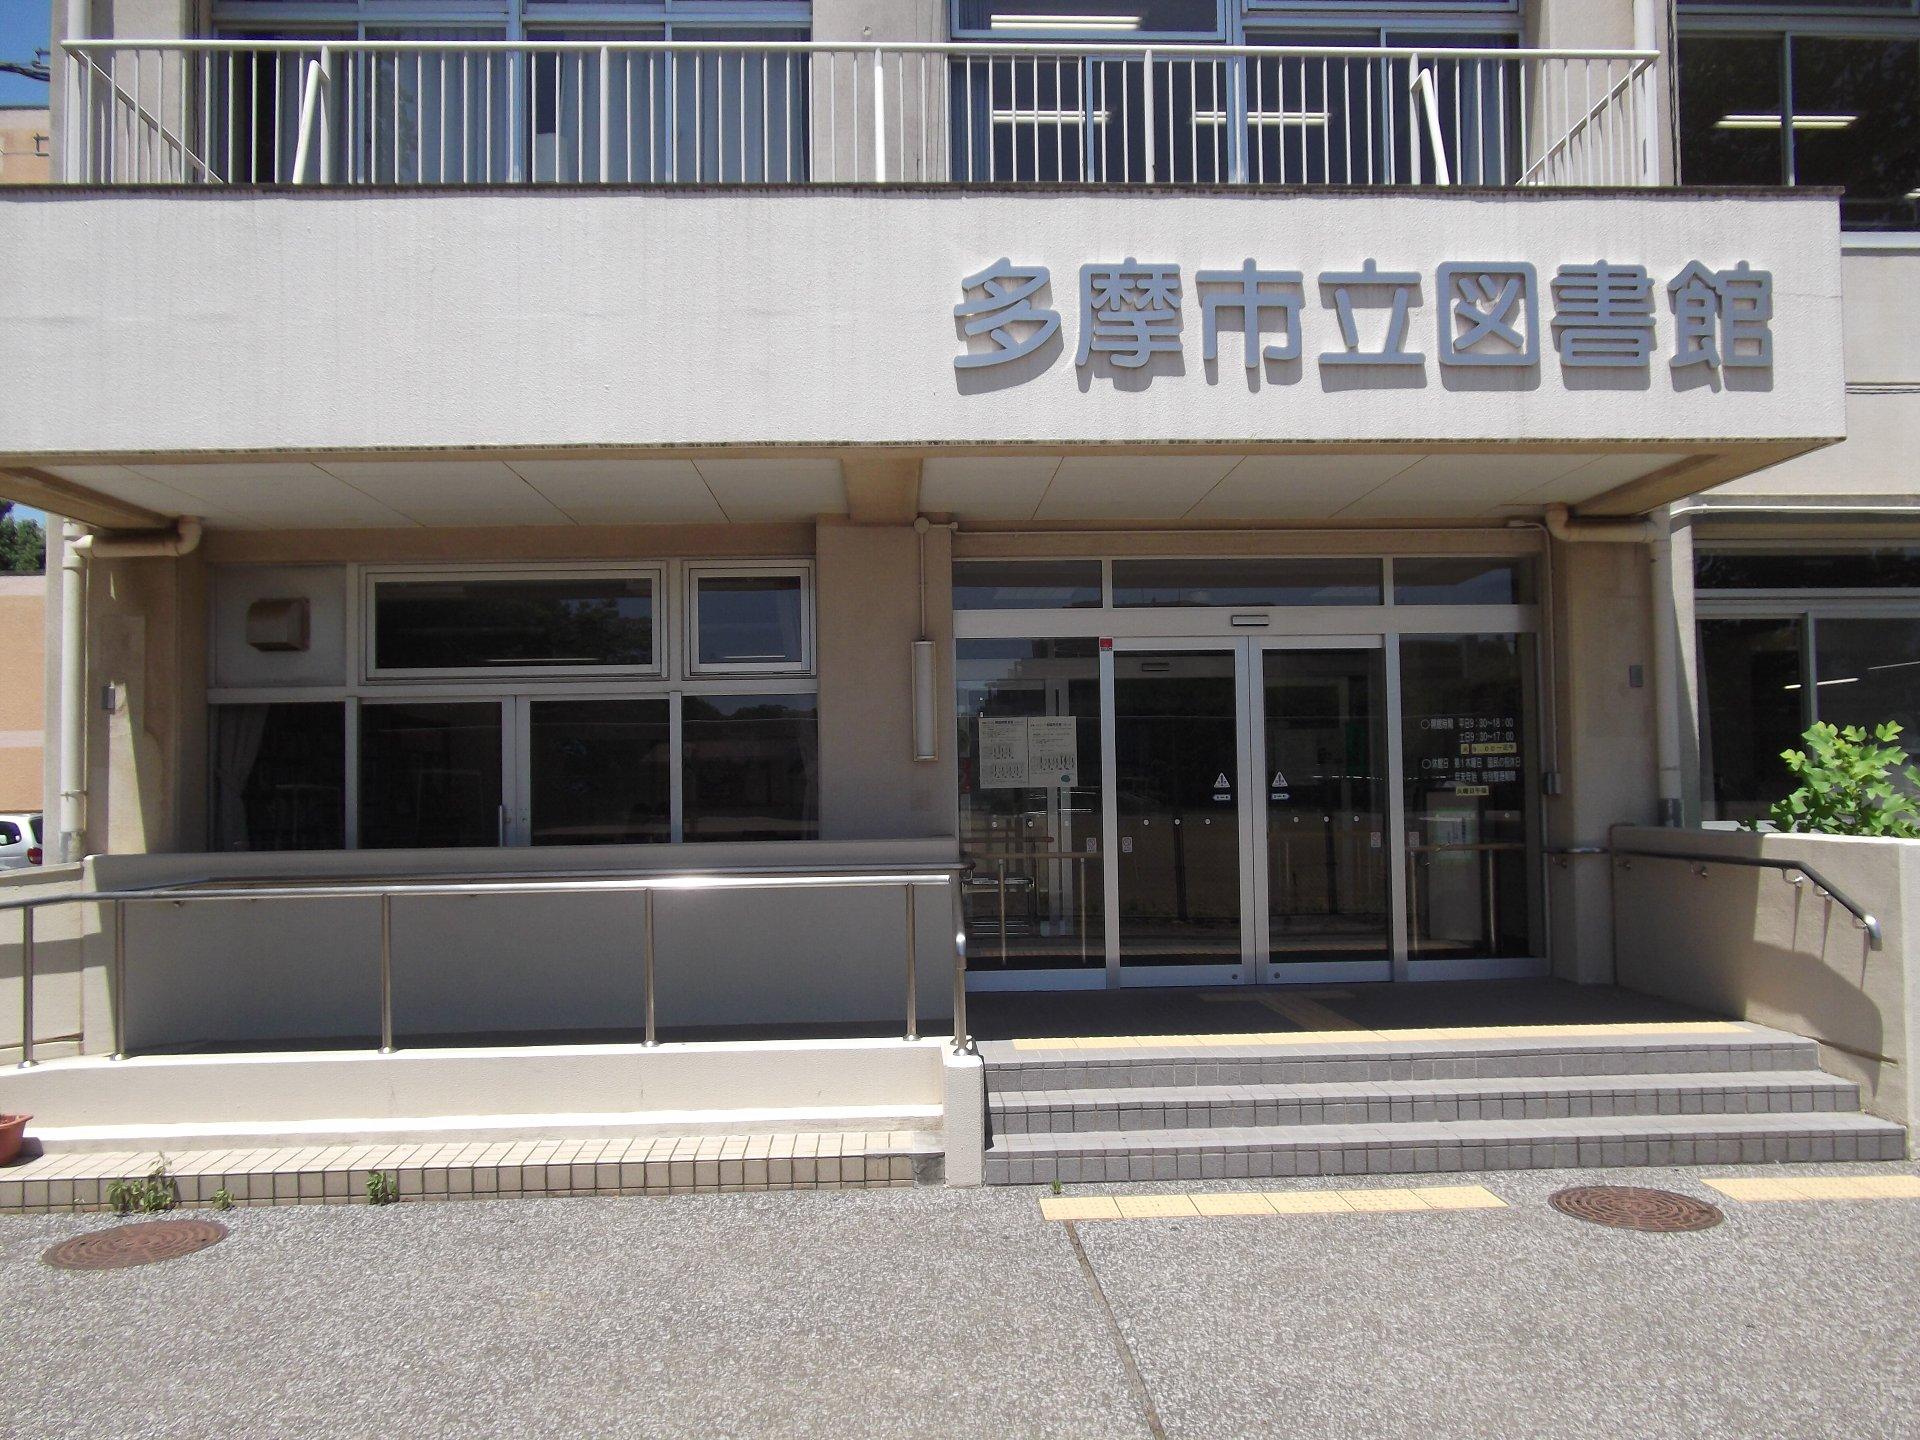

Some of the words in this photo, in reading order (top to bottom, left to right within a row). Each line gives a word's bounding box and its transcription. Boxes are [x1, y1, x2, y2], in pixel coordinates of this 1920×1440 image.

[954, 256, 1773, 370] 多摩市立図書館
